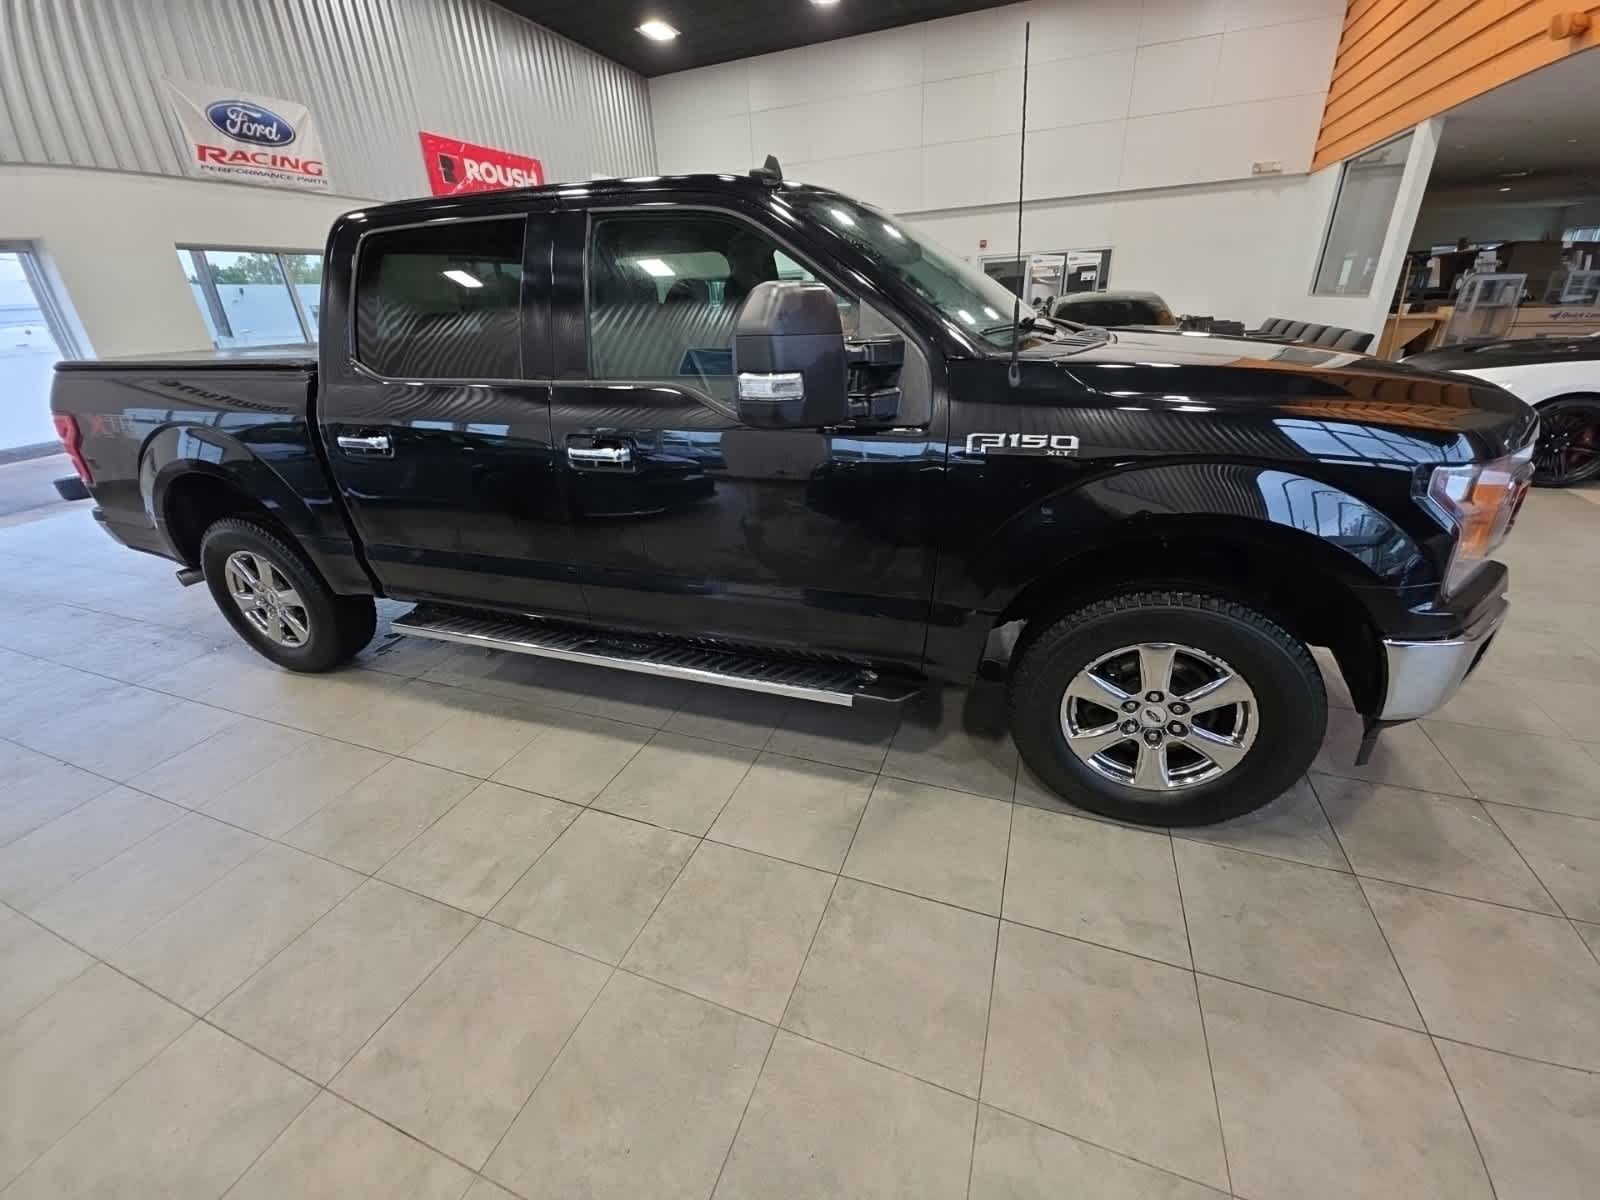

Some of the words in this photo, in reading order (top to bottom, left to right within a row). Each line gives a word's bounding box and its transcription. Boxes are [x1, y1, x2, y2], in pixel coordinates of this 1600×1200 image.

[226, 106, 281, 142] Ford
[195, 144, 323, 177] RACING
[200, 164, 294, 181] PERFORMANCE
[296, 175, 329, 186] PARTS
[463, 158, 538, 188] ROUSH
[1046, 449, 1072, 457] XLT
